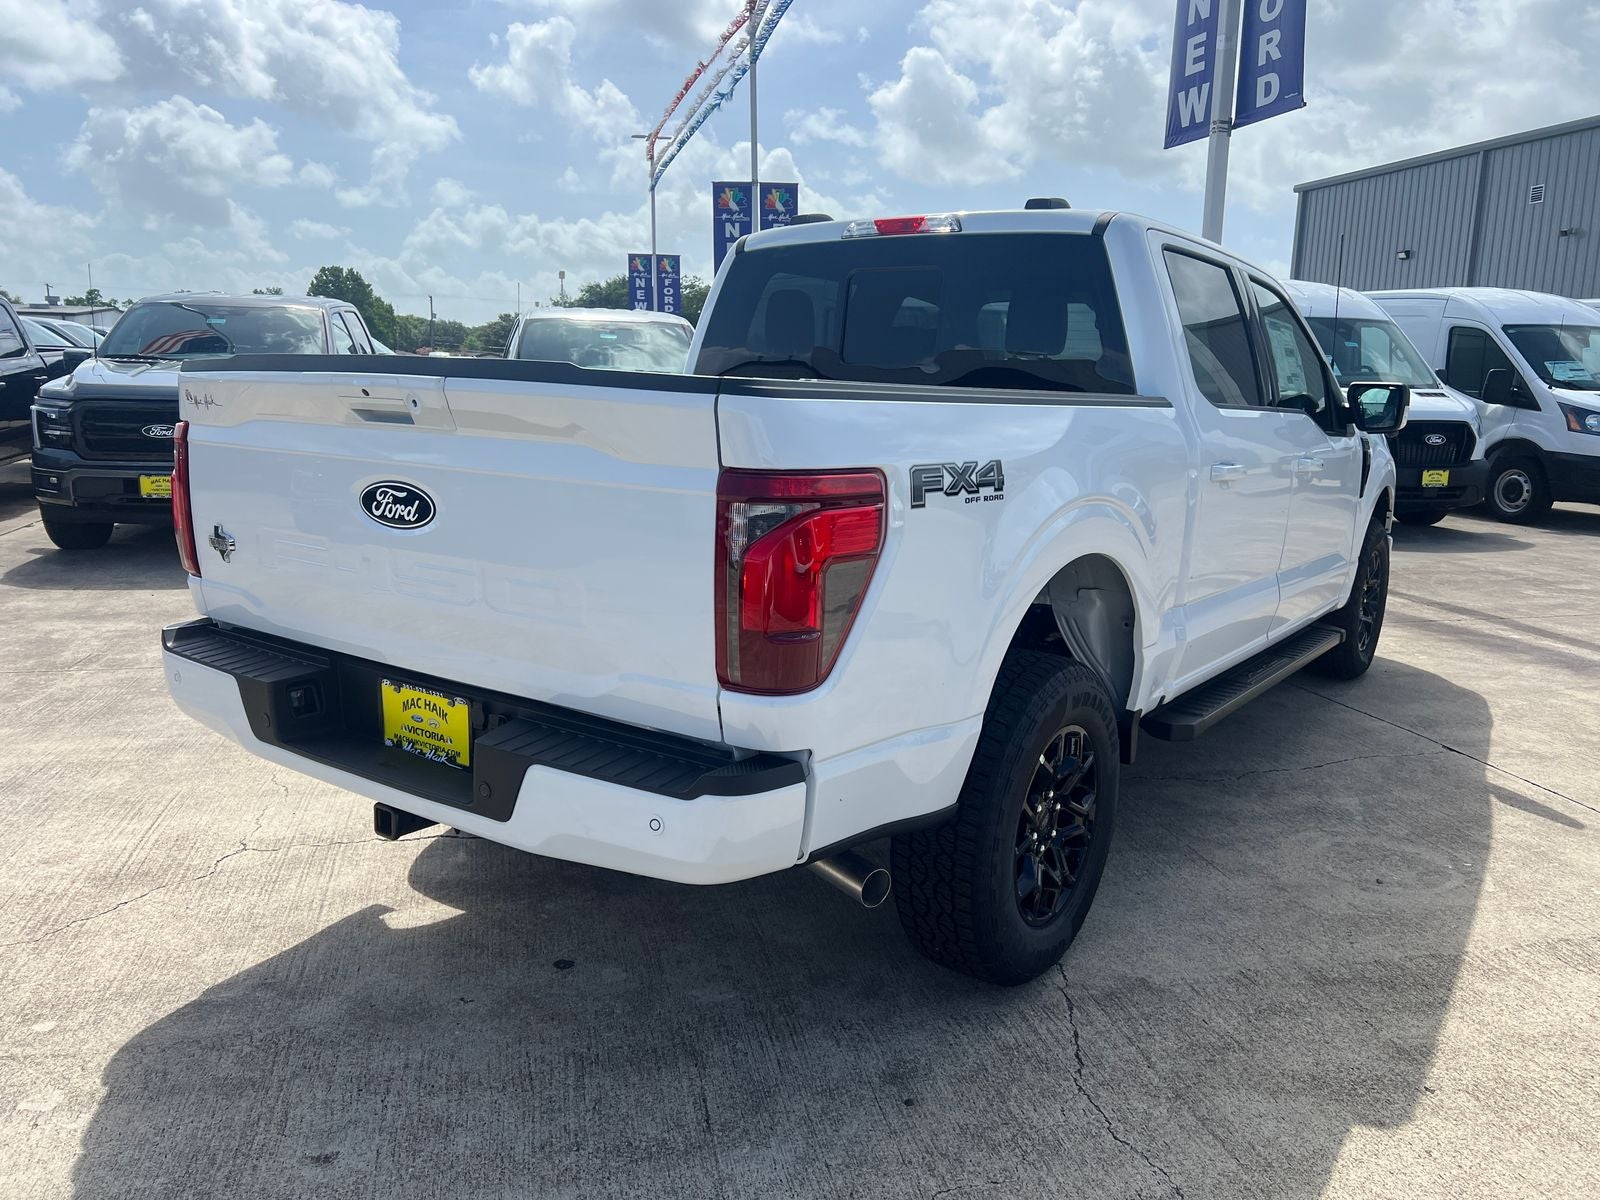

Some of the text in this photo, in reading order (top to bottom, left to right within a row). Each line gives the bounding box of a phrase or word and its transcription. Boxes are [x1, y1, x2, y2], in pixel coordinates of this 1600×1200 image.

[1255, 0, 1284, 109] ORD
[634, 277, 648, 311] NEW
[663, 278, 674, 312] FORD
[149, 425, 173, 436] Ford
[909, 459, 1005, 510] FX4
[964, 493, 1004, 504] OFF ROAD
[371, 487, 420, 522] Ford
[402, 697, 422, 713] MAC
[424, 699, 449, 724] HAIK
[407, 724, 446, 743] VICTORIA
